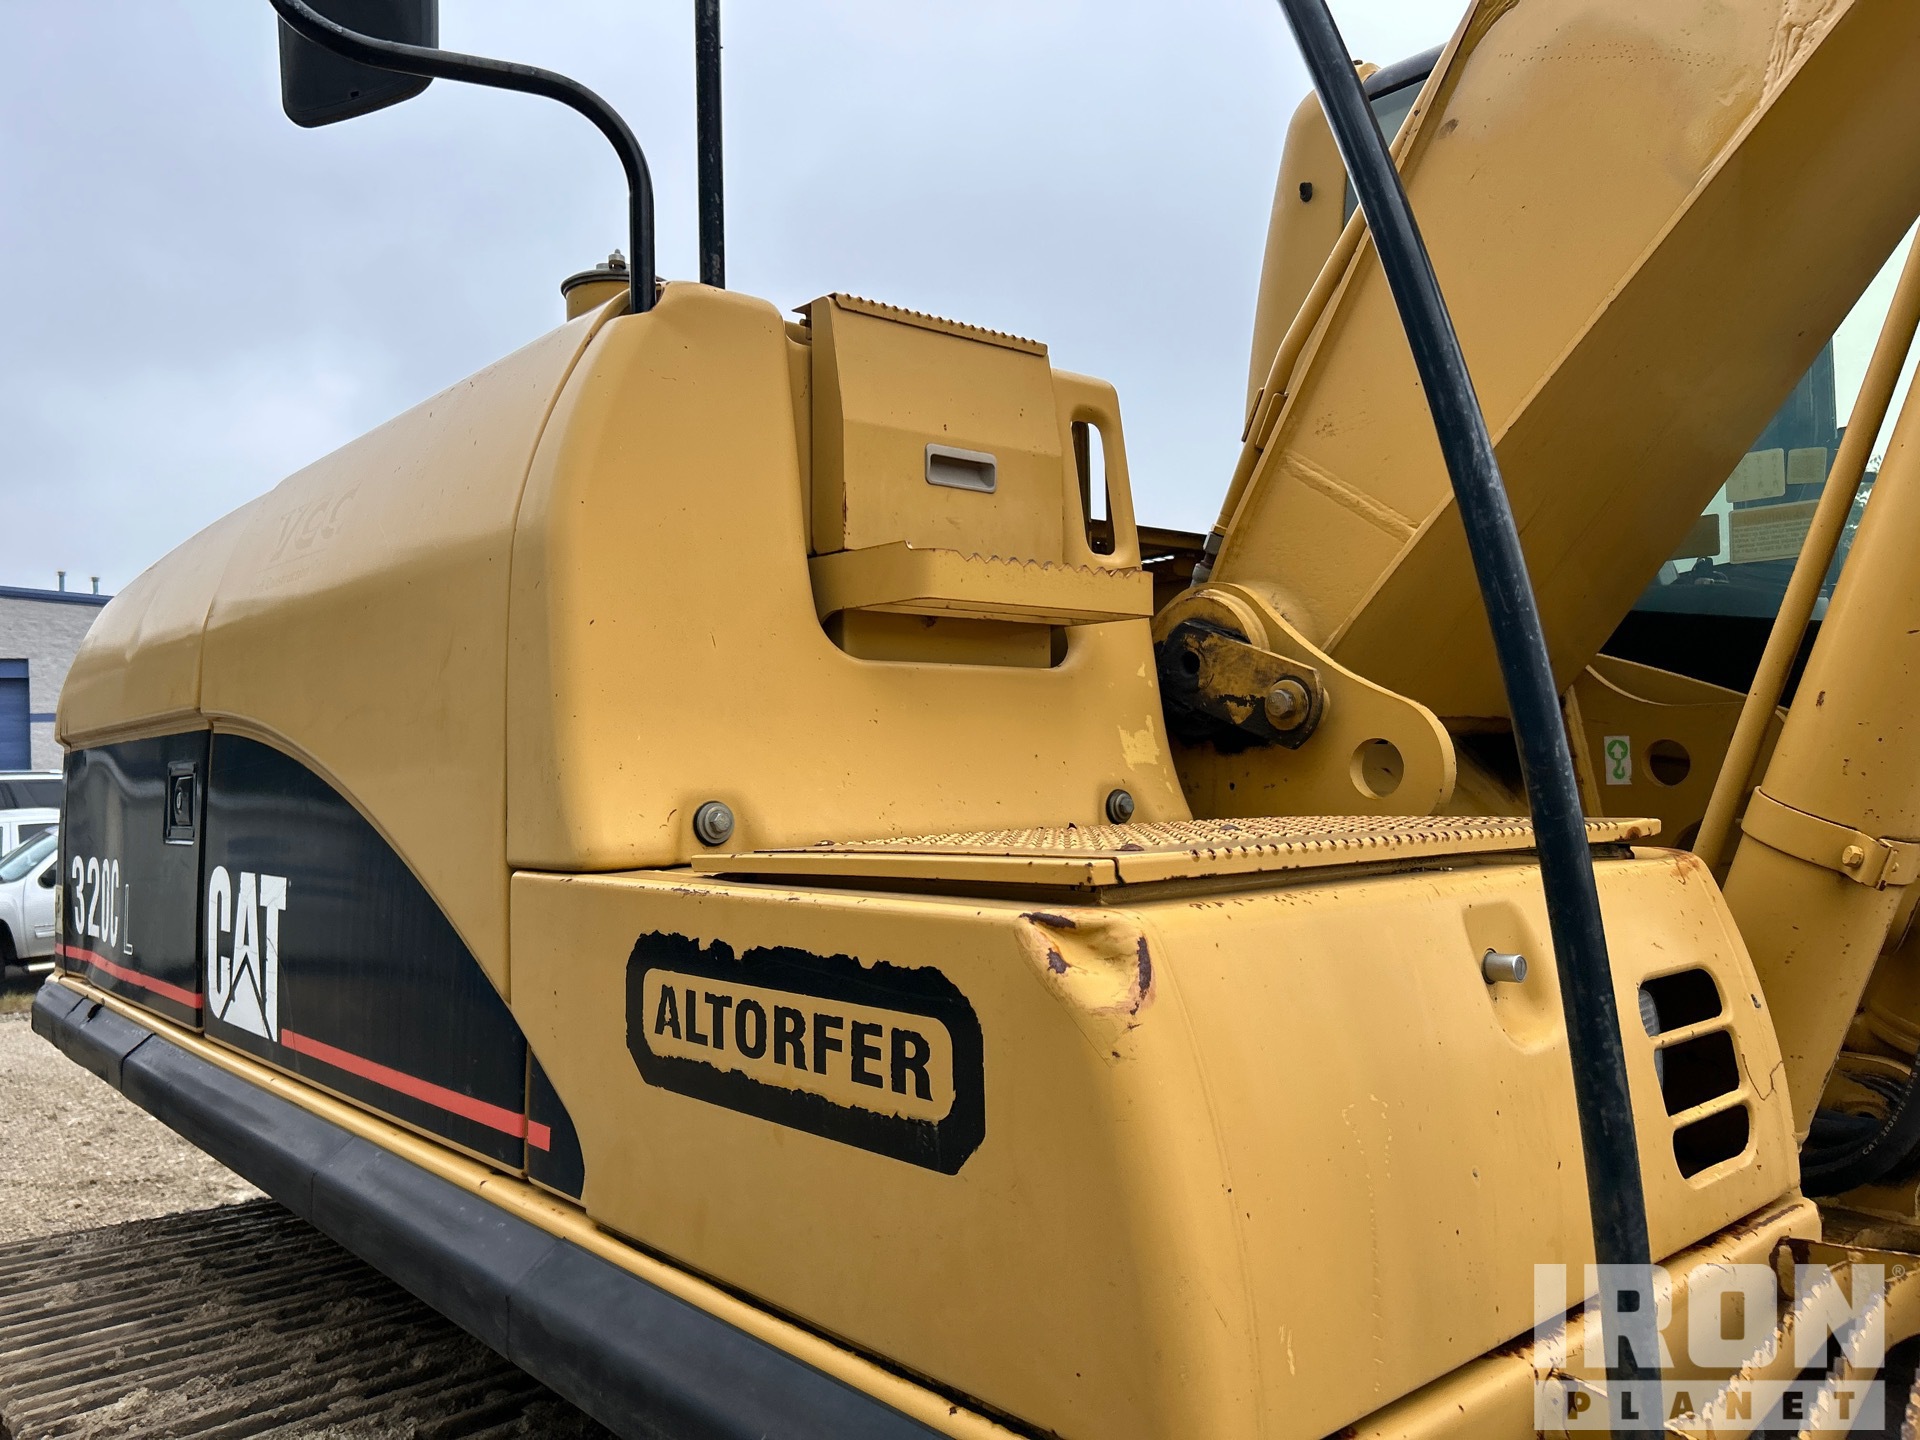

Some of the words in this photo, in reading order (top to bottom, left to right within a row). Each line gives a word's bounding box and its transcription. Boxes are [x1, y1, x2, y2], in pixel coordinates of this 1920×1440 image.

[72, 855, 120, 948] 320C
[208, 865, 288, 1043] CAT
[654, 984, 934, 1102] ALTORFER
